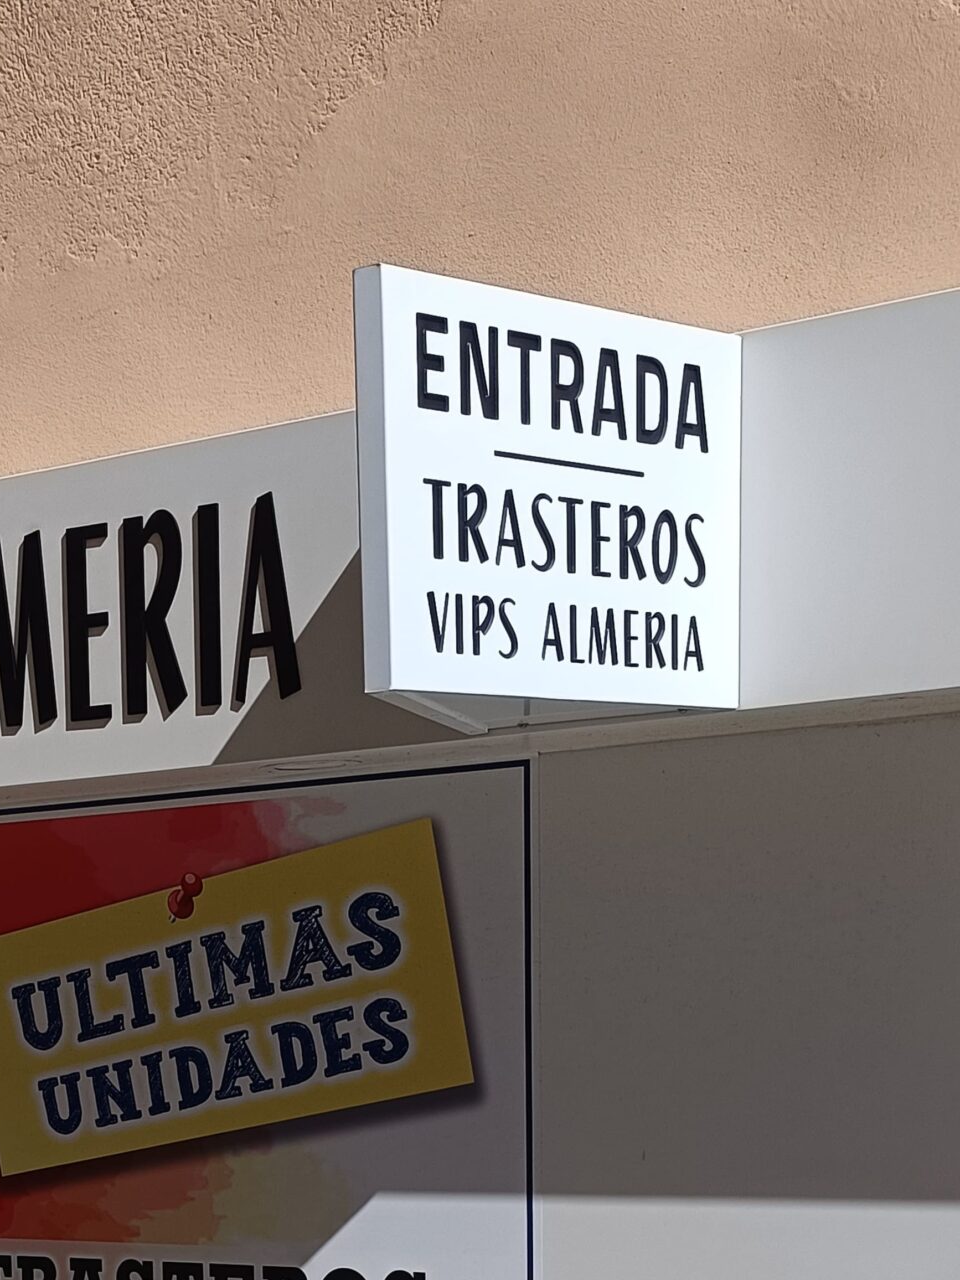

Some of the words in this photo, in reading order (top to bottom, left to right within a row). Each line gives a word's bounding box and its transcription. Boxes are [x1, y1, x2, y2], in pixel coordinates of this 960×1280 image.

[414, 311, 710, 454] ENTRADA
[423, 476, 708, 589] TRASTEROS
[425, 590, 519, 660] VIPS
[540, 600, 705, 673] ALMERIA
[11, 891, 403, 1052] ULTIMAS
[37, 996, 411, 1135] UNIDADES
